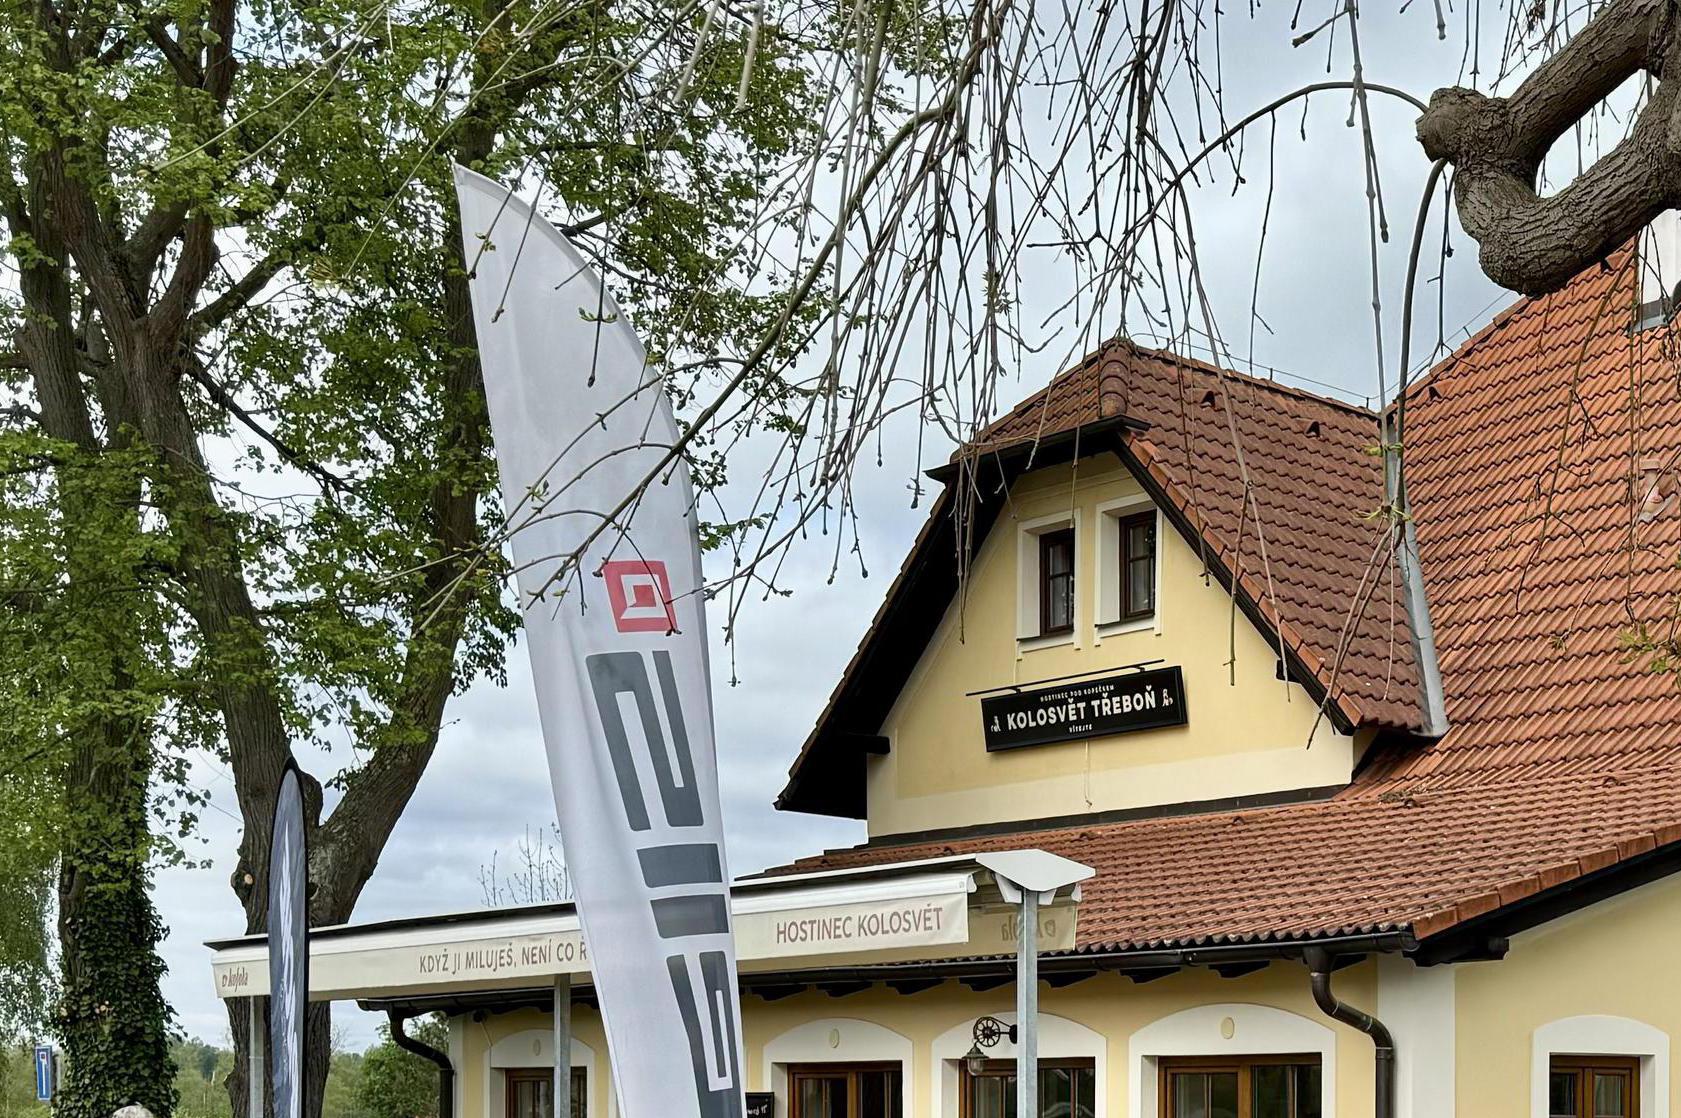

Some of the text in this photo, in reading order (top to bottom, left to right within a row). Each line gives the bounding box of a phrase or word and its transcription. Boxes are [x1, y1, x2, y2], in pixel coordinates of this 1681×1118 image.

[1007, 684, 1156, 730] KOLOSVĚT TŘEBOŇ
[776, 903, 943, 945] HOSTINEC KOLOSVĚT
[419, 947, 449, 974] KDYŽ
[451, 950, 461, 975] JI
[465, 942, 517, 973] MILUJEŠ,
[521, 938, 552, 966] NENÍ
[556, 942, 575, 963] CO
